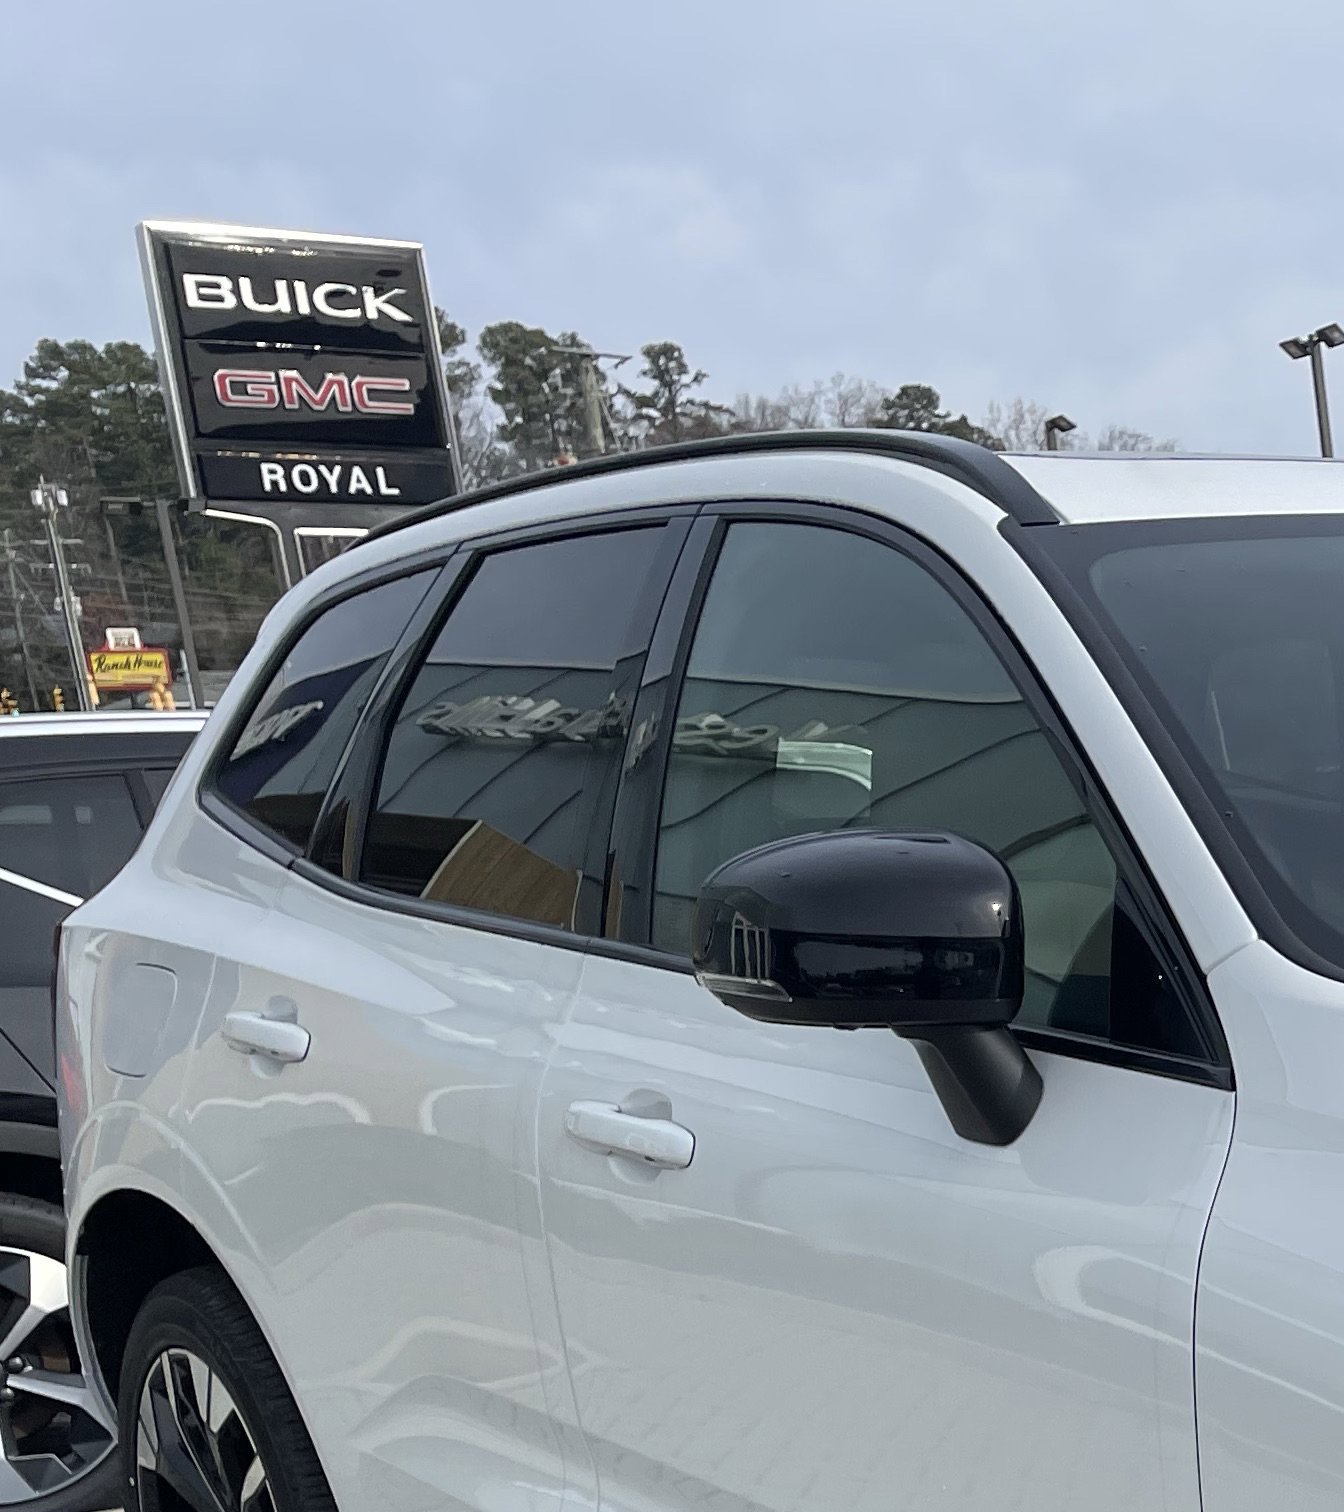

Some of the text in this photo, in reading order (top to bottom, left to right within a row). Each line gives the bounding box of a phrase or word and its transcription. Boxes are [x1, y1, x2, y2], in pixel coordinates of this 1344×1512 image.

[182, 273, 414, 322] BUICK
[213, 369, 414, 415] GMC
[260, 462, 400, 496] ROYAL
[95, 653, 131, 673] Ranch
